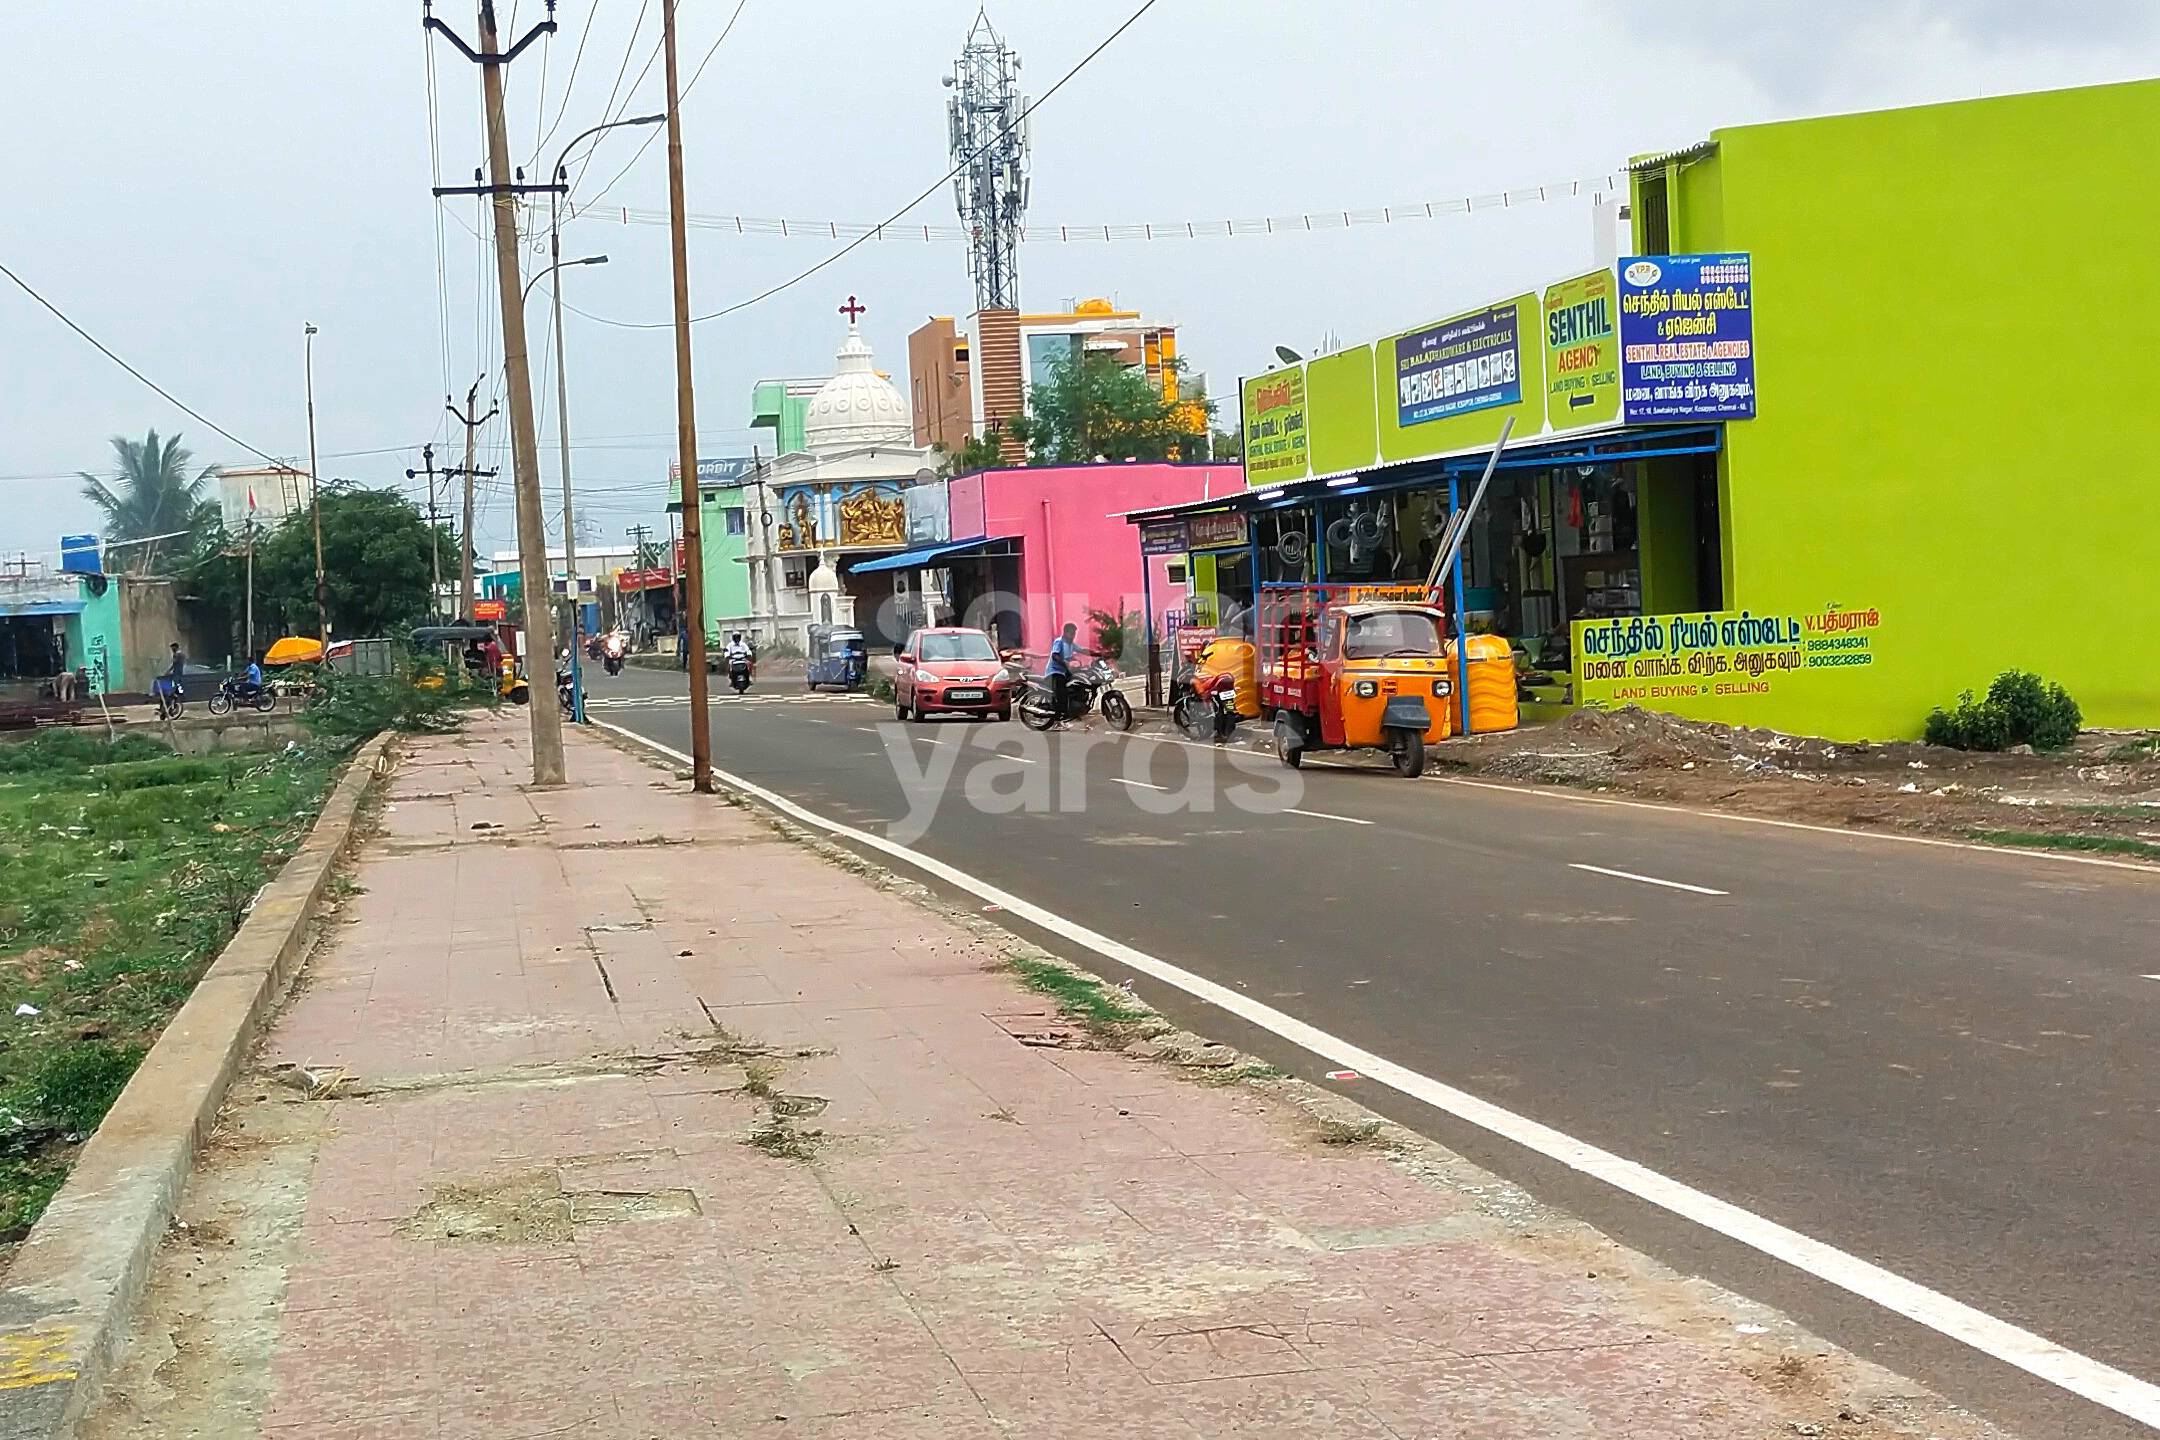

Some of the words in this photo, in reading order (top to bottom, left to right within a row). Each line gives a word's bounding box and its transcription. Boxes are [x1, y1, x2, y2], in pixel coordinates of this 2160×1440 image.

[1623, 289, 1670, 318] செந்தில்
[1672, 288, 1702, 311] ரியல்
[1548, 298, 1612, 347] SENTHIL
[1657, 321, 1664, 336] &
[1472, 329, 1512, 351] ELECTRICALS
[1558, 343, 1600, 373] AGENCY
[1627, 345, 1658, 363] SENTHIL
[1659, 345, 1678, 361] REAL
[1679, 343, 1707, 360] ESTATE
[1713, 342, 1749, 358] AGENCIES
[1592, 371, 1615, 386] SELLING
[1665, 364, 1695, 379] BUYING
[1703, 362, 1736, 377] SELLING
[698, 462, 736, 475] ORBIT
[1584, 617, 1664, 660] செந்தில்
[1670, 614, 1718, 654] ரியல்
[1721, 611, 1800, 647] எஸ்டேட்
[1613, 687, 1646, 699] LAND
[1651, 685, 1697, 698] BUYING
[1715, 682, 1769, 695] SELLING
